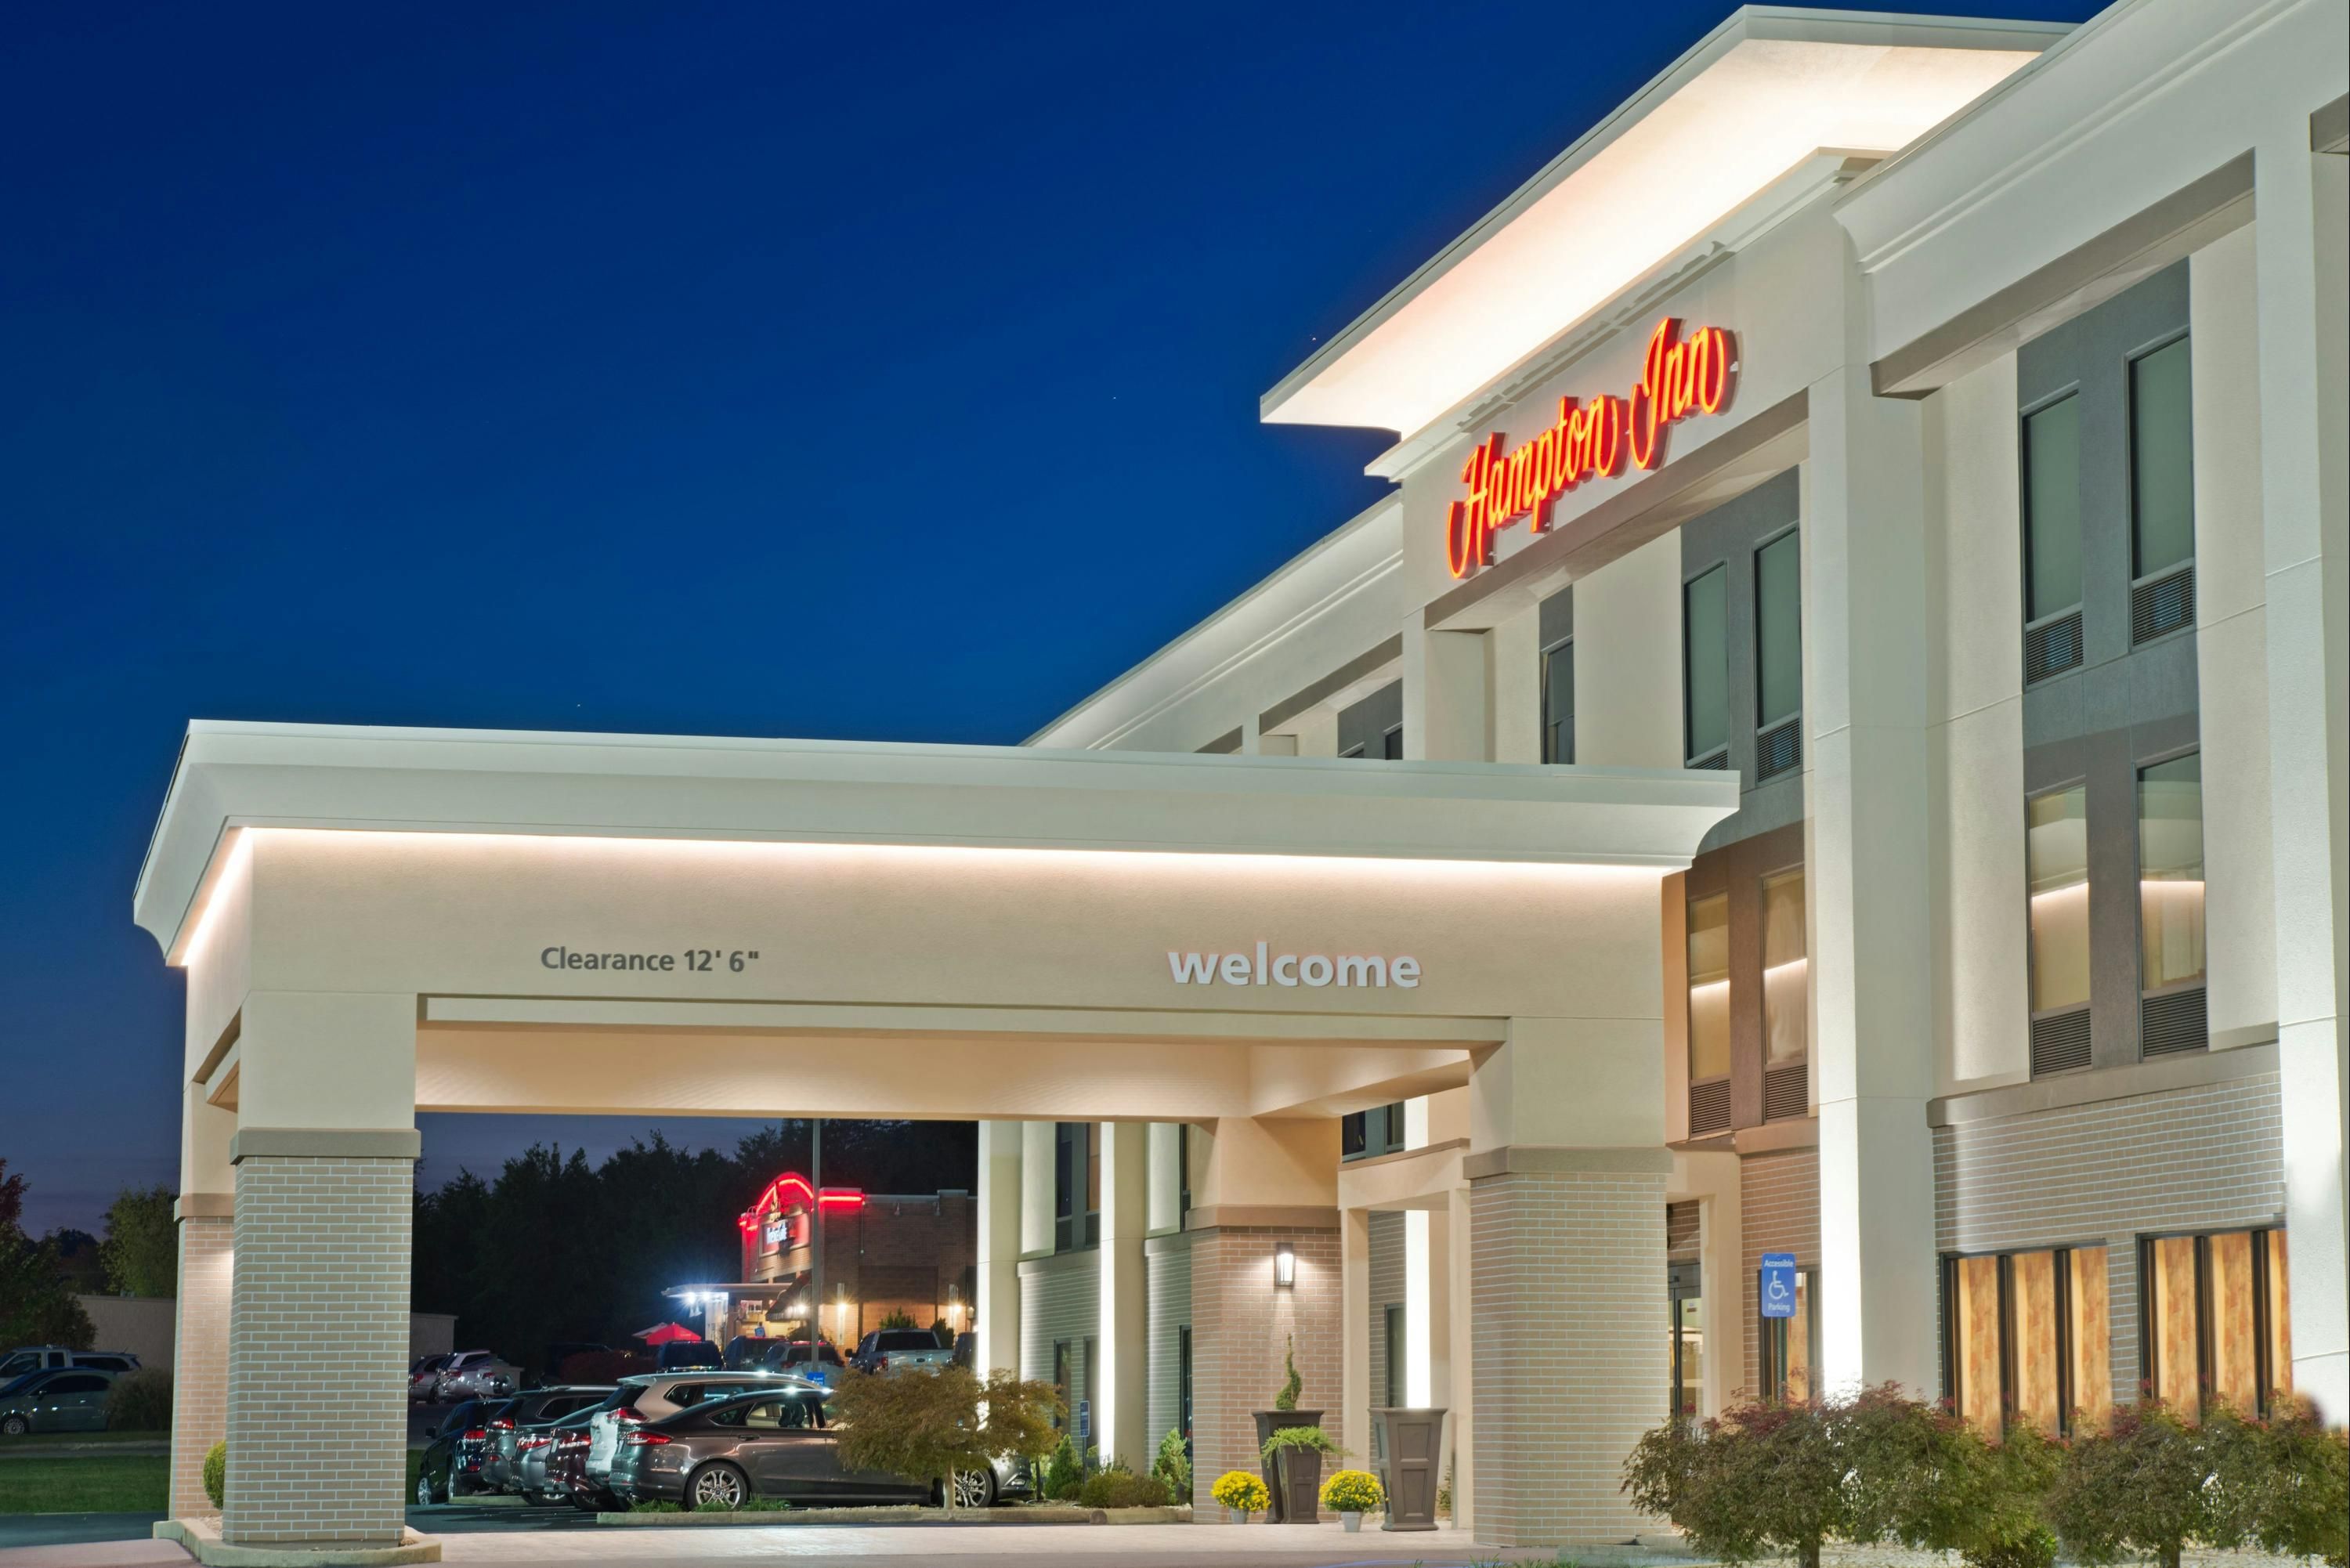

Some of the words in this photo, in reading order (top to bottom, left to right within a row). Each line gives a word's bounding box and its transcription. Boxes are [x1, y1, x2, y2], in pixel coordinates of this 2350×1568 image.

[1446, 395, 1629, 580] Hampton
[1629, 316, 1739, 471] Inn
[540, 945, 675, 971] Clearance
[683, 949, 721, 971] 12'
[728, 950, 760, 973] 6"
[1167, 941, 1423, 988] welcome
[1763, 1259, 1794, 1268] Accessible
[1767, 1302, 1791, 1313] Parking
